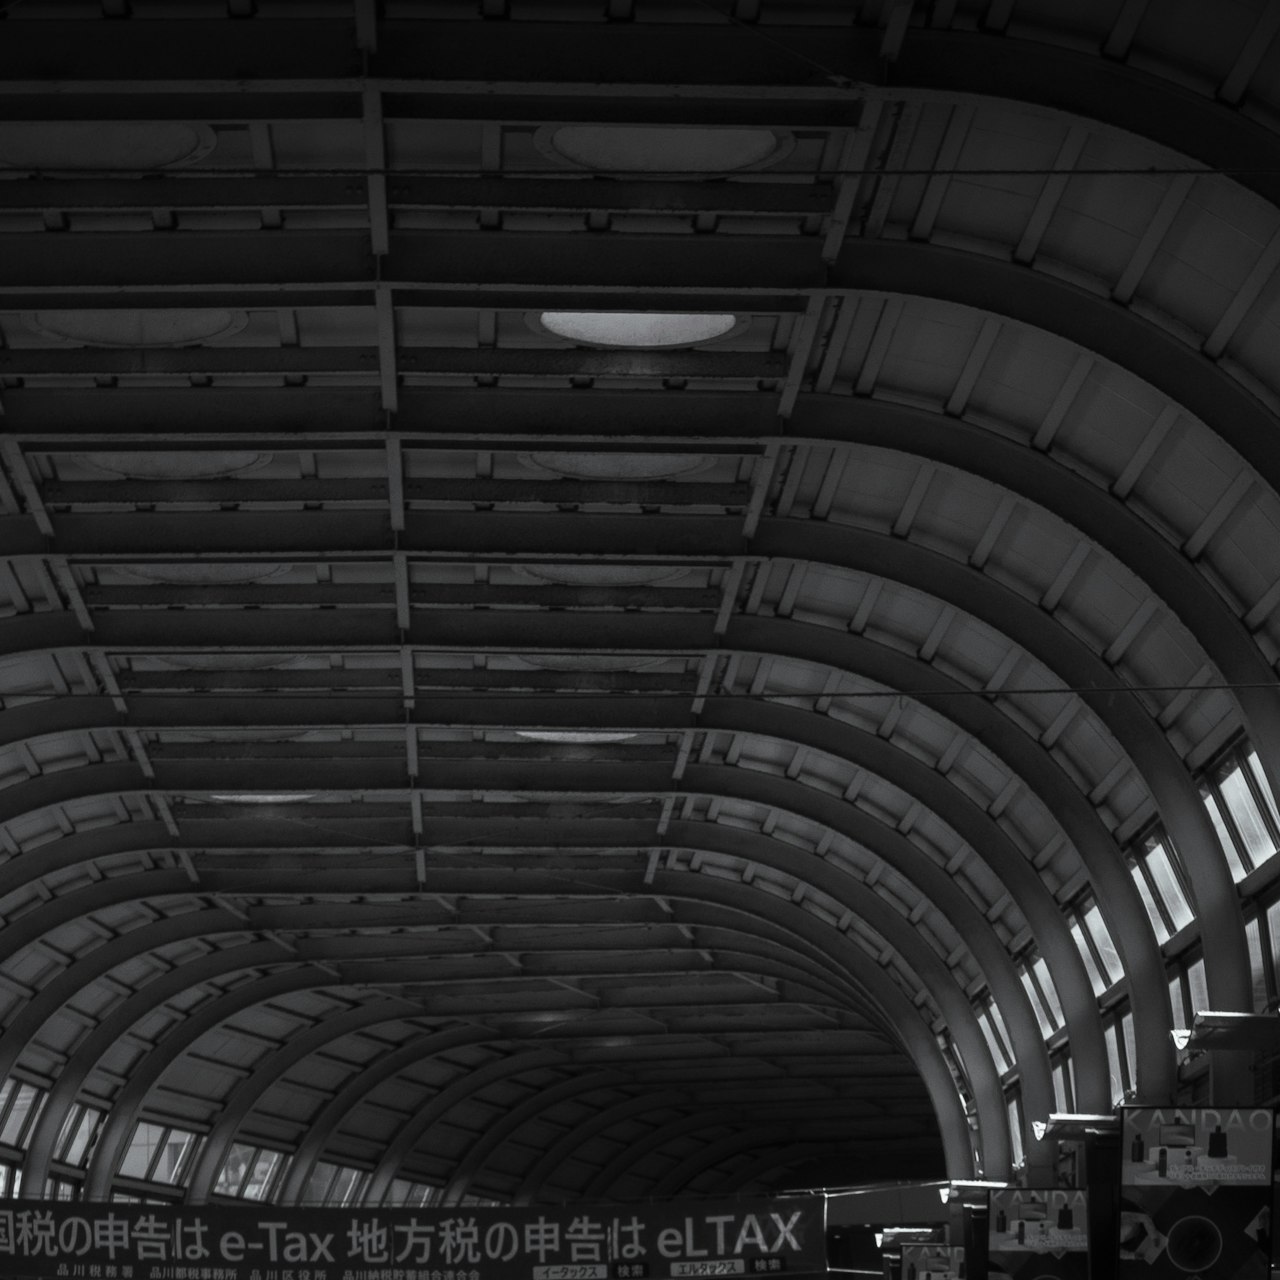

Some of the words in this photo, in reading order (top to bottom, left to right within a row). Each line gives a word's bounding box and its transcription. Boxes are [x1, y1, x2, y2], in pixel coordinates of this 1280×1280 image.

[1122, 1108, 1273, 1131] KANDAO
[220, 1221, 335, 1263] e-Tax
[346, 1216, 646, 1265] 地方税の申告は
[656, 1211, 802, 1258] eLTAX
[542, 1266, 599, 1279] イータックス
[678, 1261, 737, 1274] エルタックス
